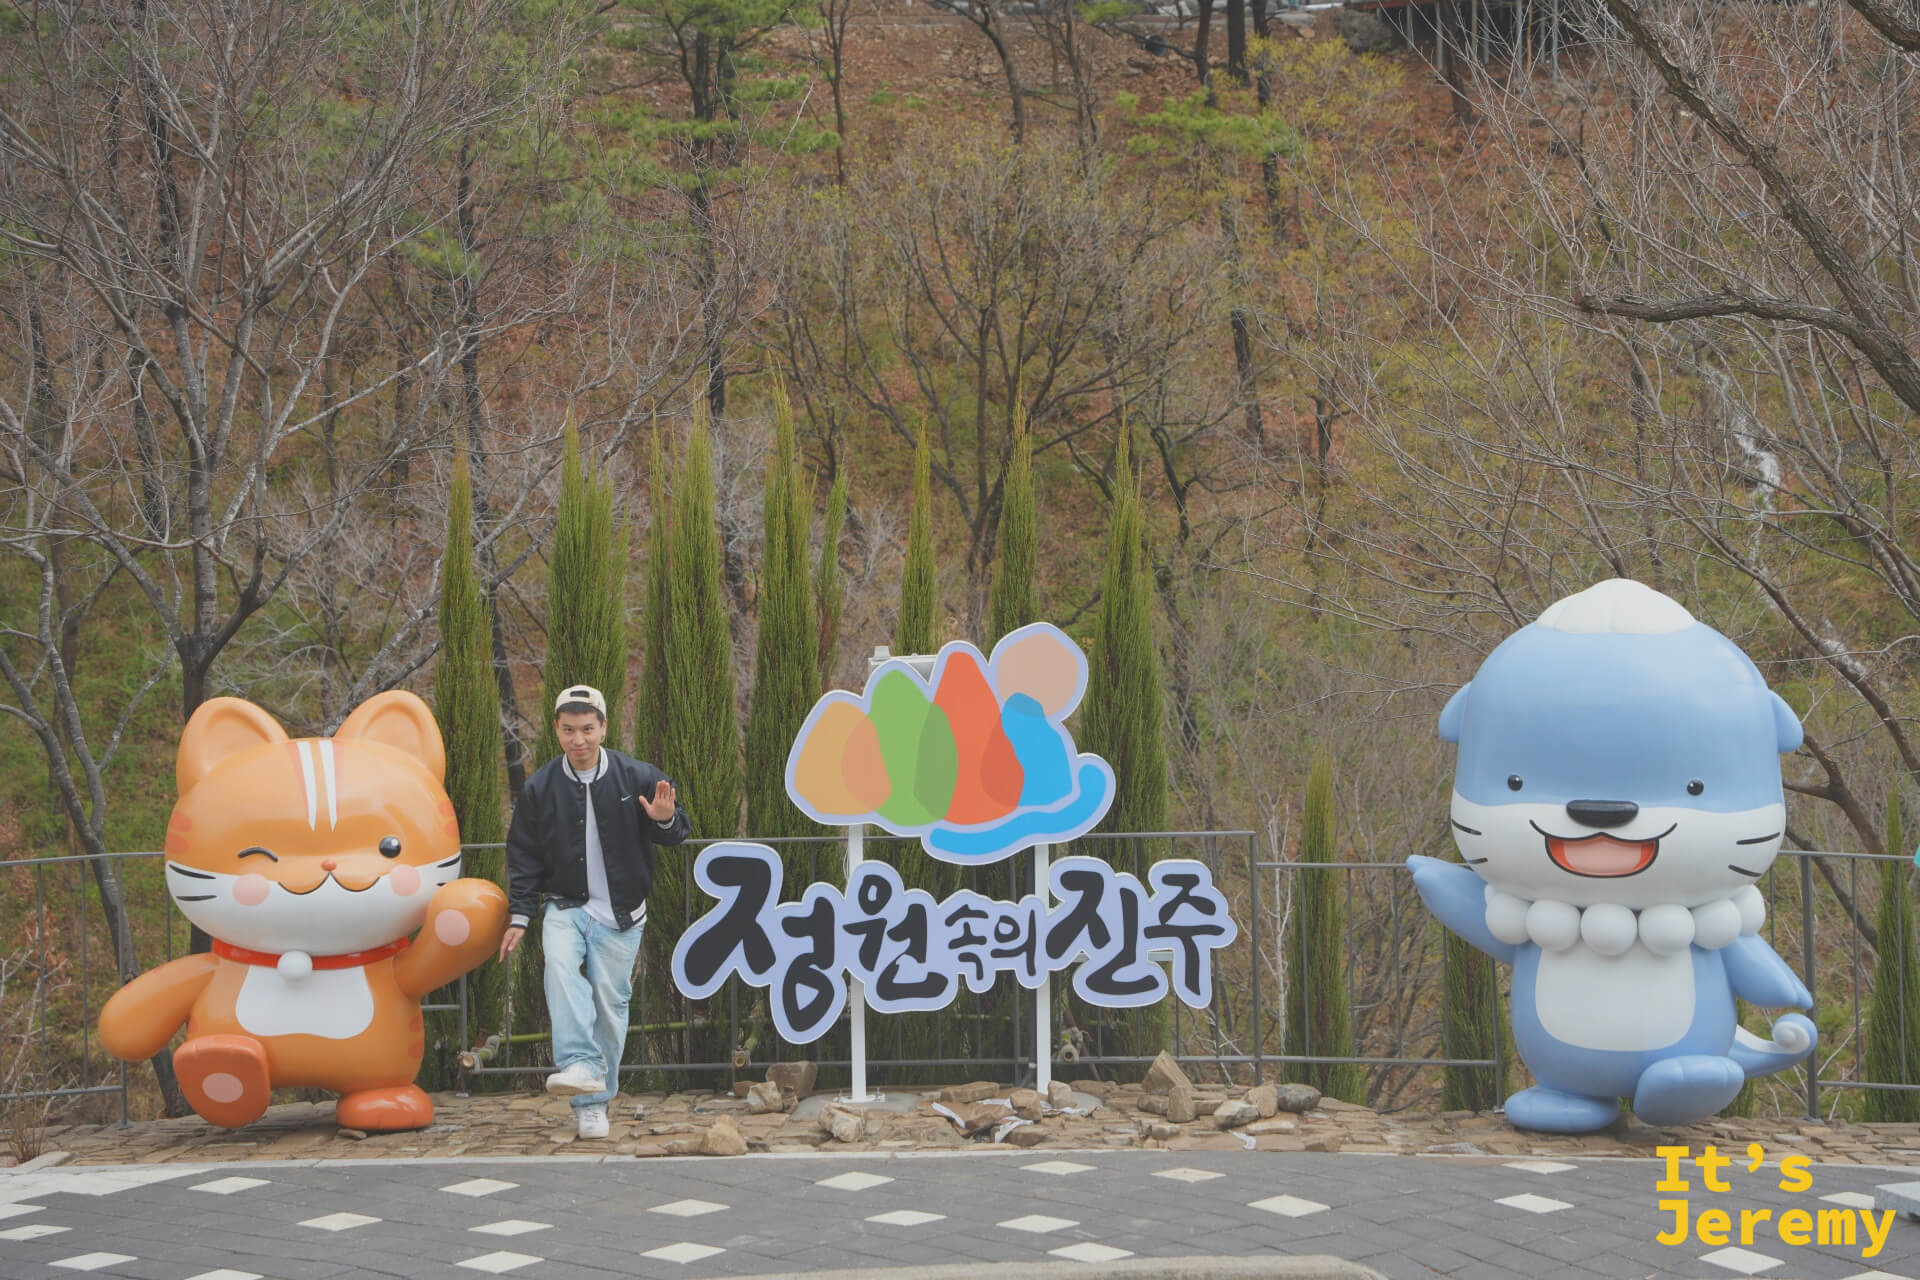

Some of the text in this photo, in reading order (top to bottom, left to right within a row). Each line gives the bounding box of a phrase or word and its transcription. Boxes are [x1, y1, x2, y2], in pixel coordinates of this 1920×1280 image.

[684, 855, 1225, 1032] 정원 속의 진주
